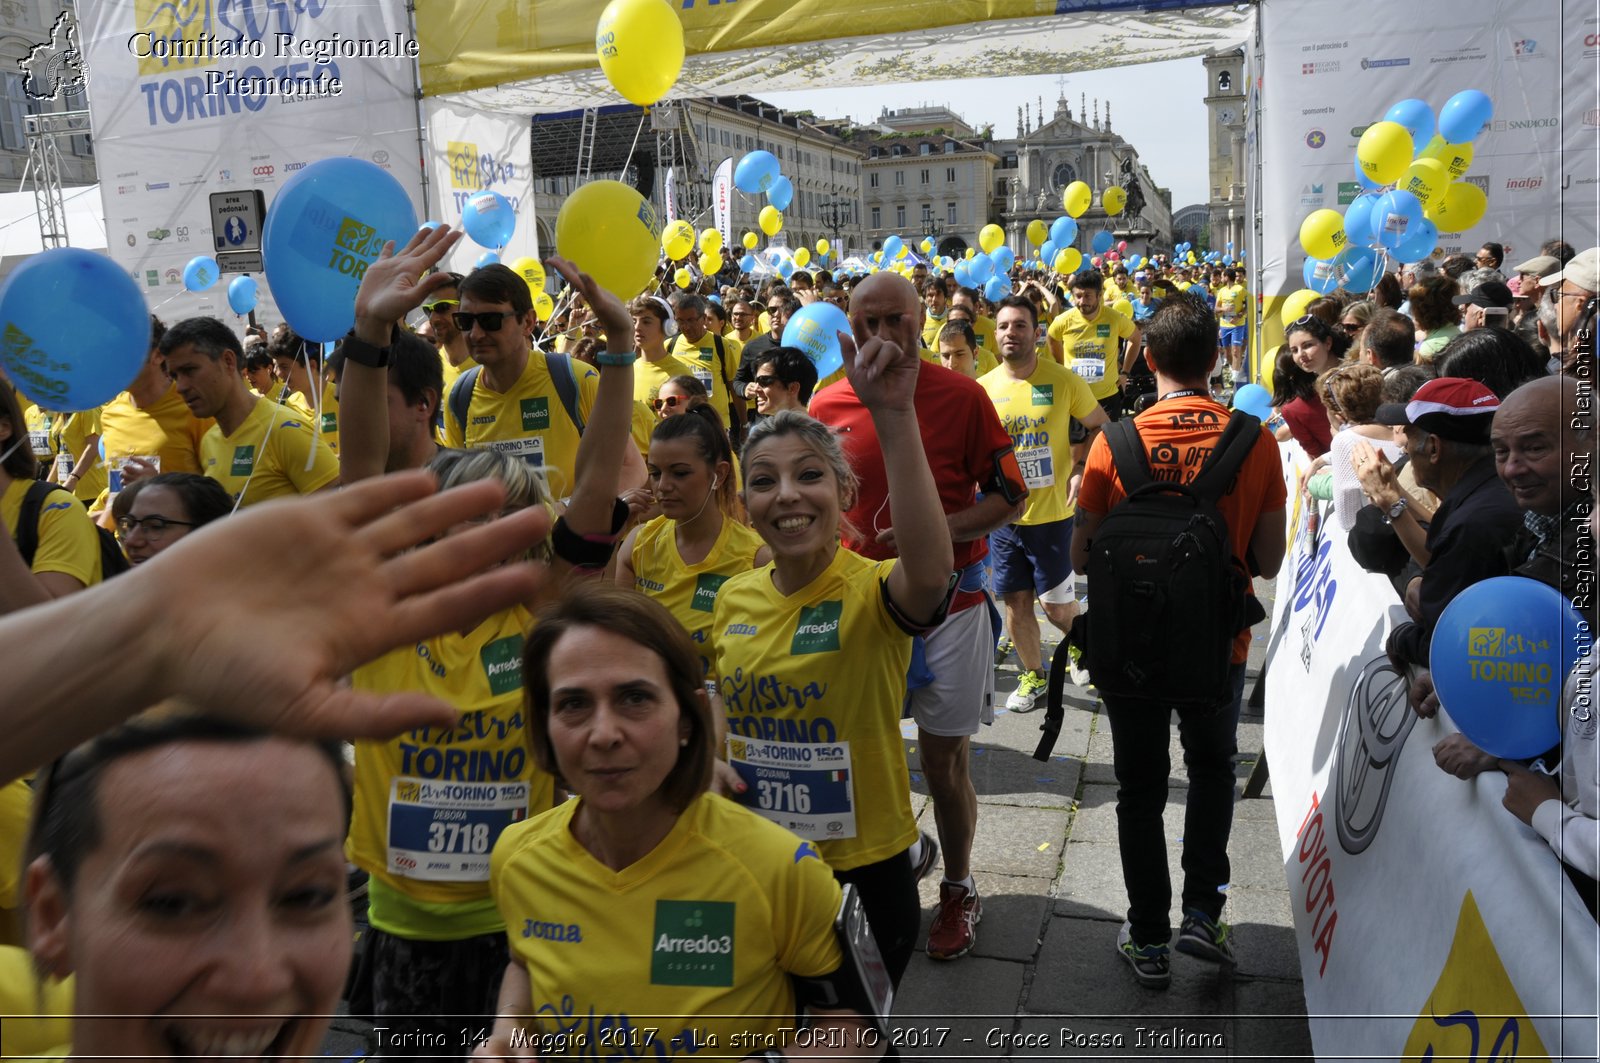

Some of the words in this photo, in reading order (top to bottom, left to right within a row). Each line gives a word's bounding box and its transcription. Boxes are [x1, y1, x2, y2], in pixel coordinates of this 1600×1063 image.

[1316, 42, 1342, 52] patrocinio
[141, 66, 267, 125] TORINO
[1302, 107, 1328, 115] sponsored
[1329, 106, 1335, 114] by
[253, 165, 274, 177] coop
[1406, 185, 1430, 200] TORINO
[1505, 177, 1542, 189] inalpi
[218, 204, 248, 213] pedonale
[797, 331, 827, 353] TORINO
[522, 408, 548, 419] Arredo3
[1017, 415, 1048, 431] Stra
[1168, 410, 1219, 430] 150
[795, 619, 838, 637] Arredo3
[1508, 634, 1550, 655] Stra
[1468, 659, 1553, 684] TORINO
[758, 674, 828, 710] Stra
[1508, 686, 1551, 700] 150
[457, 709, 525, 742] Stra
[728, 717, 836, 744] TORINO
[814, 746, 844, 757] 150
[399, 743, 526, 783] TORINO
[755, 768, 791, 780] GIOVANNA
[757, 780, 812, 814] 3716
[433, 809, 467, 821] DEBORA
[428, 822, 490, 854] 3718
[1296, 790, 1338, 979] TOYOTA
[655, 932, 732, 954] Arredo3
